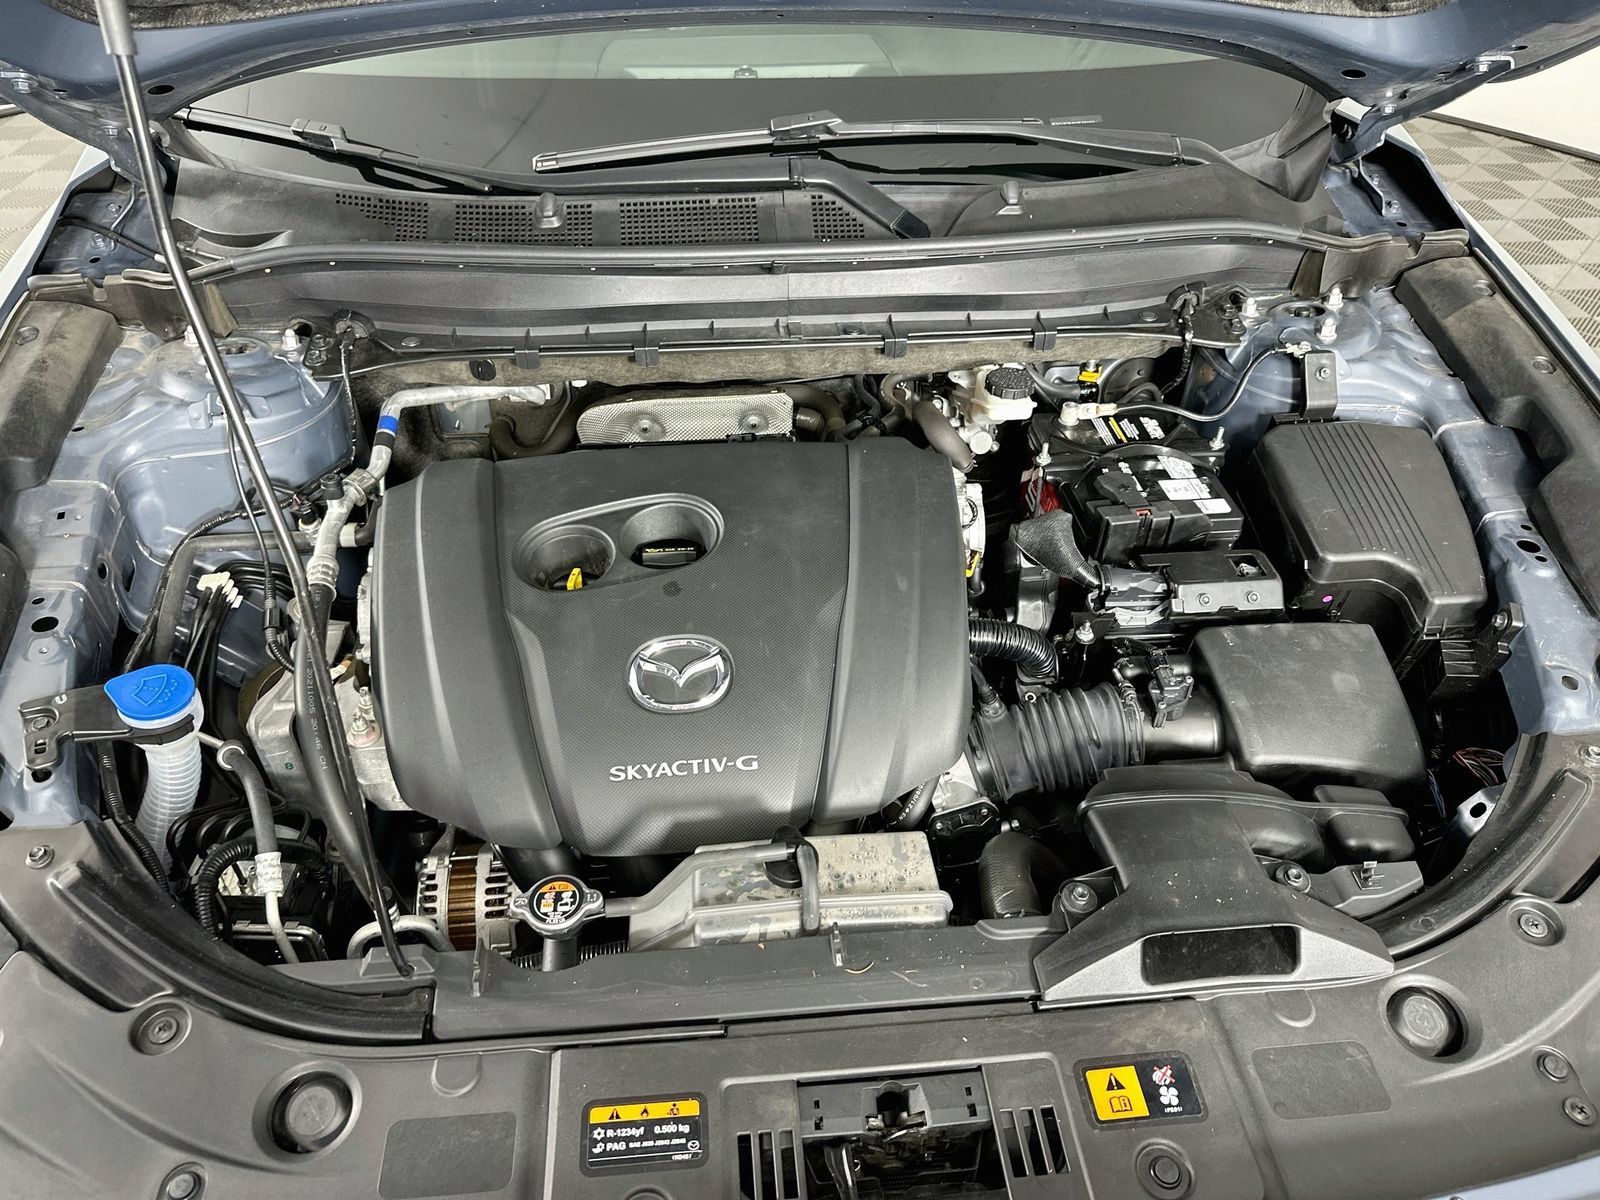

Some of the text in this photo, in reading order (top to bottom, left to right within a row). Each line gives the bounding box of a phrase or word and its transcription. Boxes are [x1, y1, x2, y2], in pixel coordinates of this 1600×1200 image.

[609, 754, 759, 782] SKYACTIV-G
[606, 1123, 690, 1138] R-1234yf 0.500 kg
[606, 1141, 627, 1151] PAG
